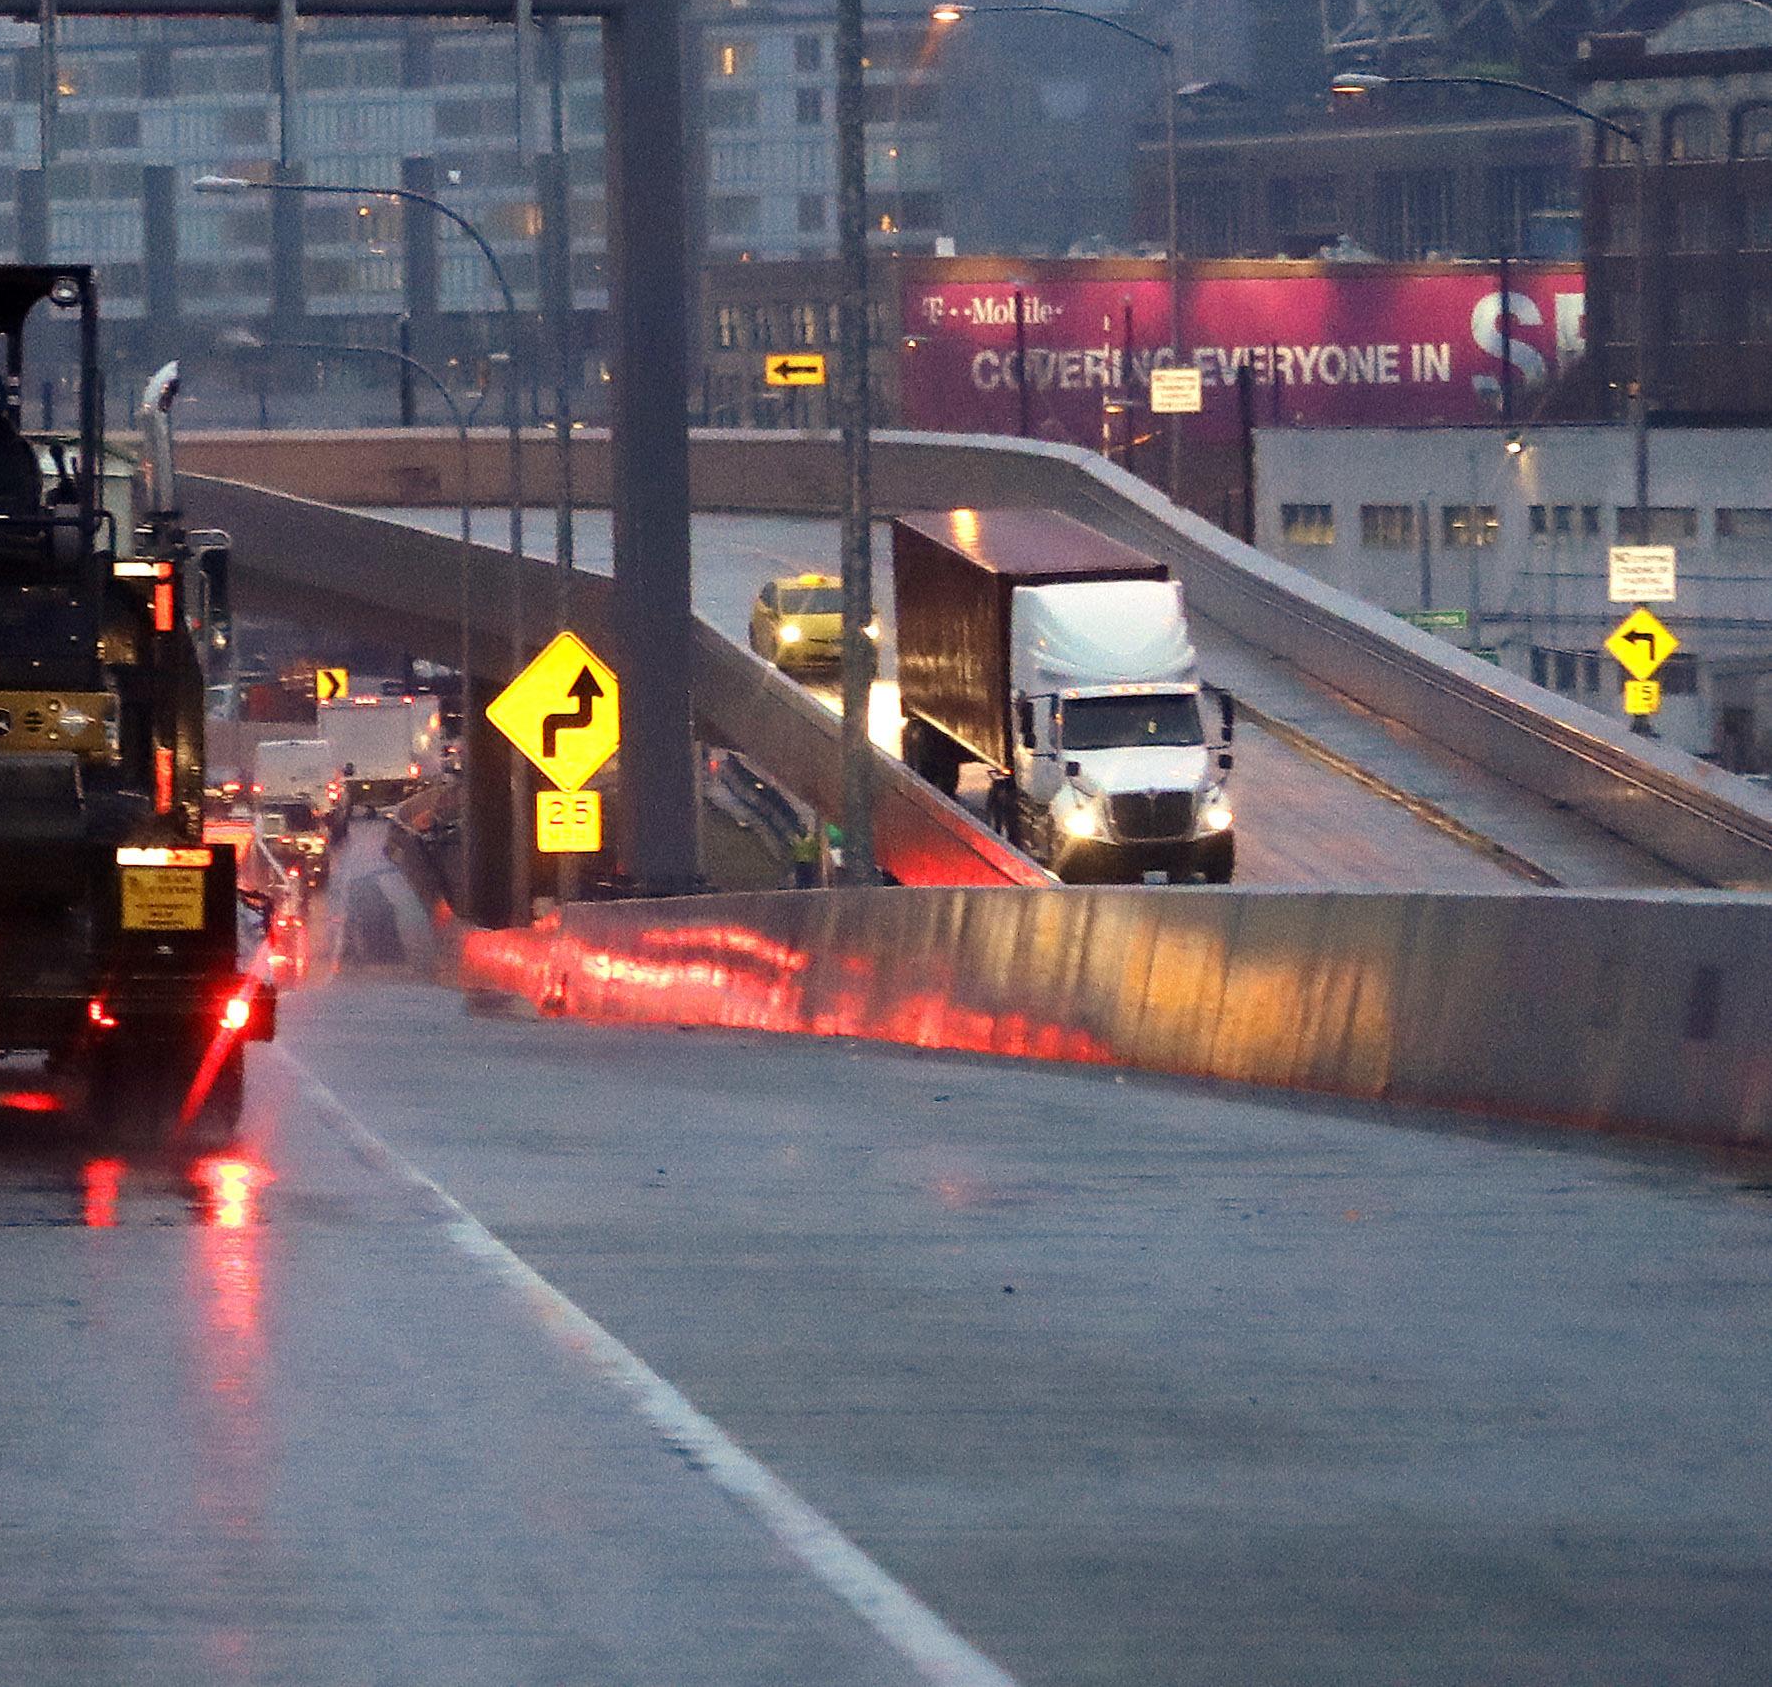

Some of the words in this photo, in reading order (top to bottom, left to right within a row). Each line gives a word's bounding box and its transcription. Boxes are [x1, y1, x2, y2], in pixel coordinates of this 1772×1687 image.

[1193, 342, 1402, 386] EVERYONE
[1410, 340, 1452, 383] IN
[547, 800, 592, 825] 25
